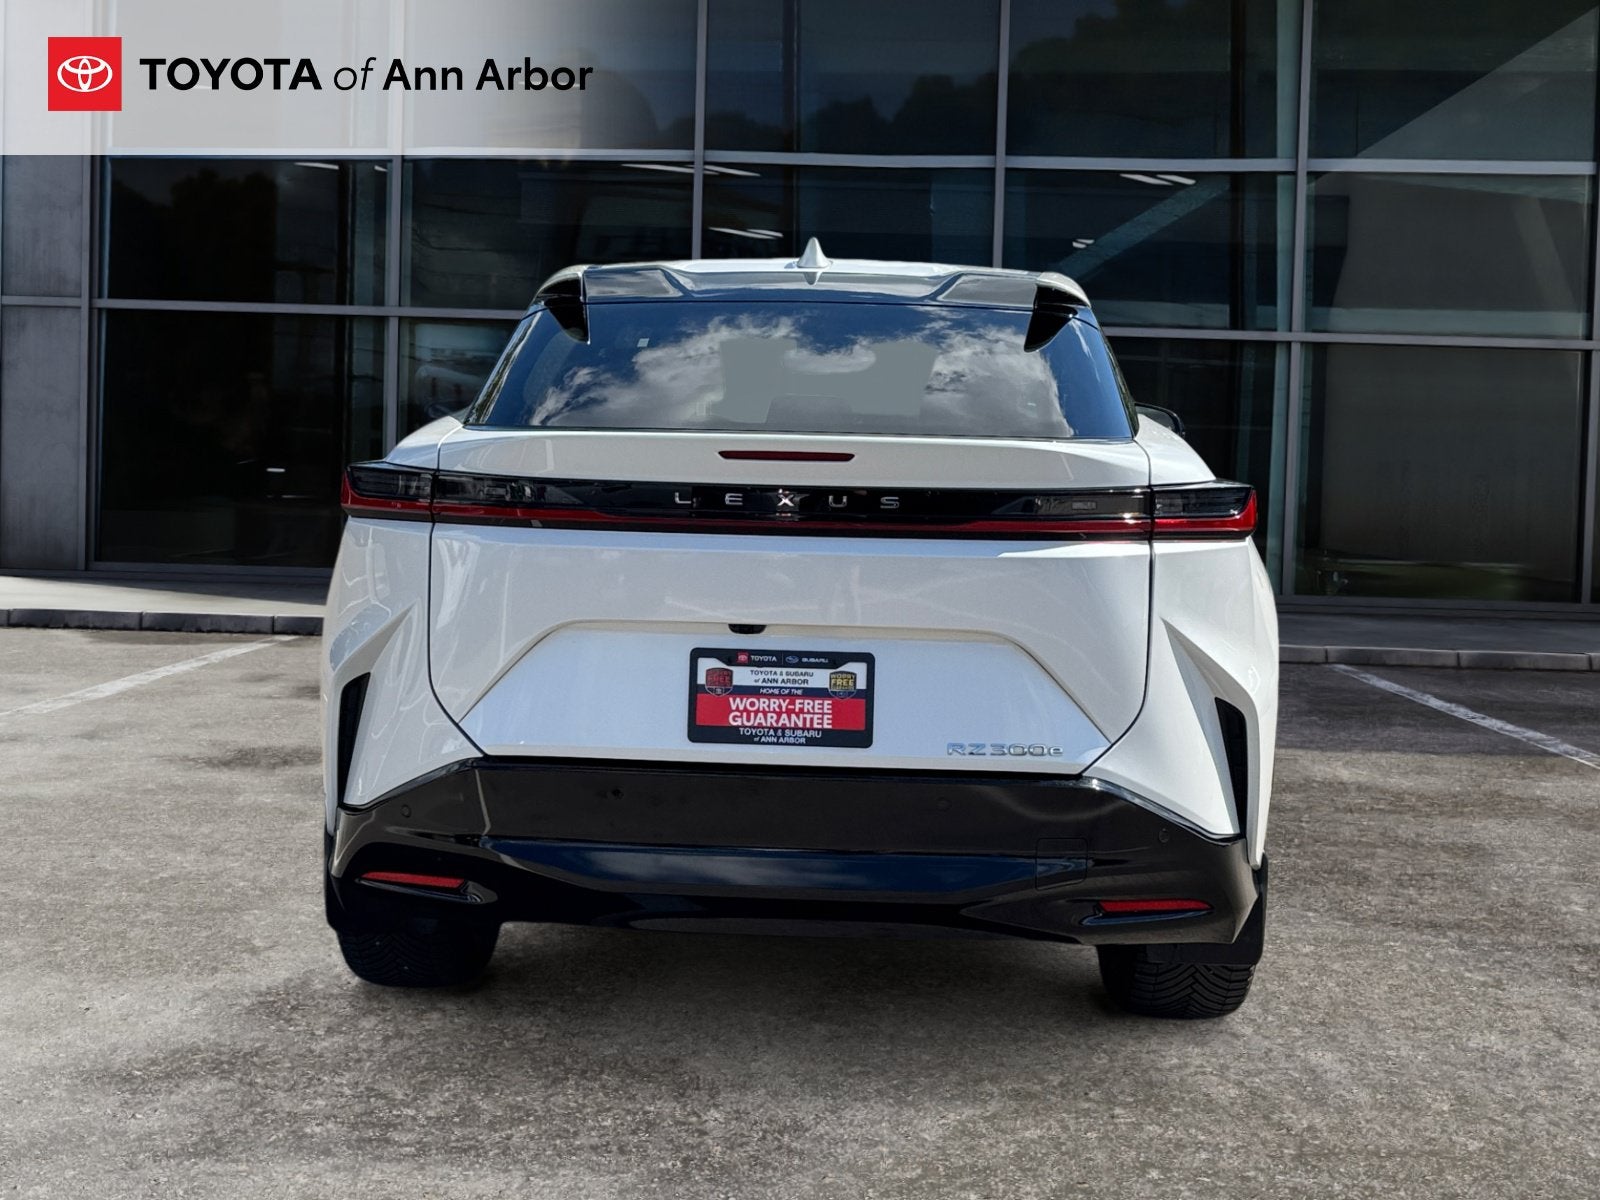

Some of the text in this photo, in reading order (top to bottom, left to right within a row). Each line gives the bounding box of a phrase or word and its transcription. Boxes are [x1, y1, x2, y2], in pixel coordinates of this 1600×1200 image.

[674, 491, 900, 509] LEXUS
[761, 677, 779, 685] ANN
[780, 678, 809, 686] ARBOR
[831, 679, 854, 688] FREE
[728, 697, 832, 713] WORRY-FREE
[728, 712, 832, 728] GUARANTEE
[739, 728, 775, 737] TOYOTA
[784, 730, 822, 738] SUBARU
